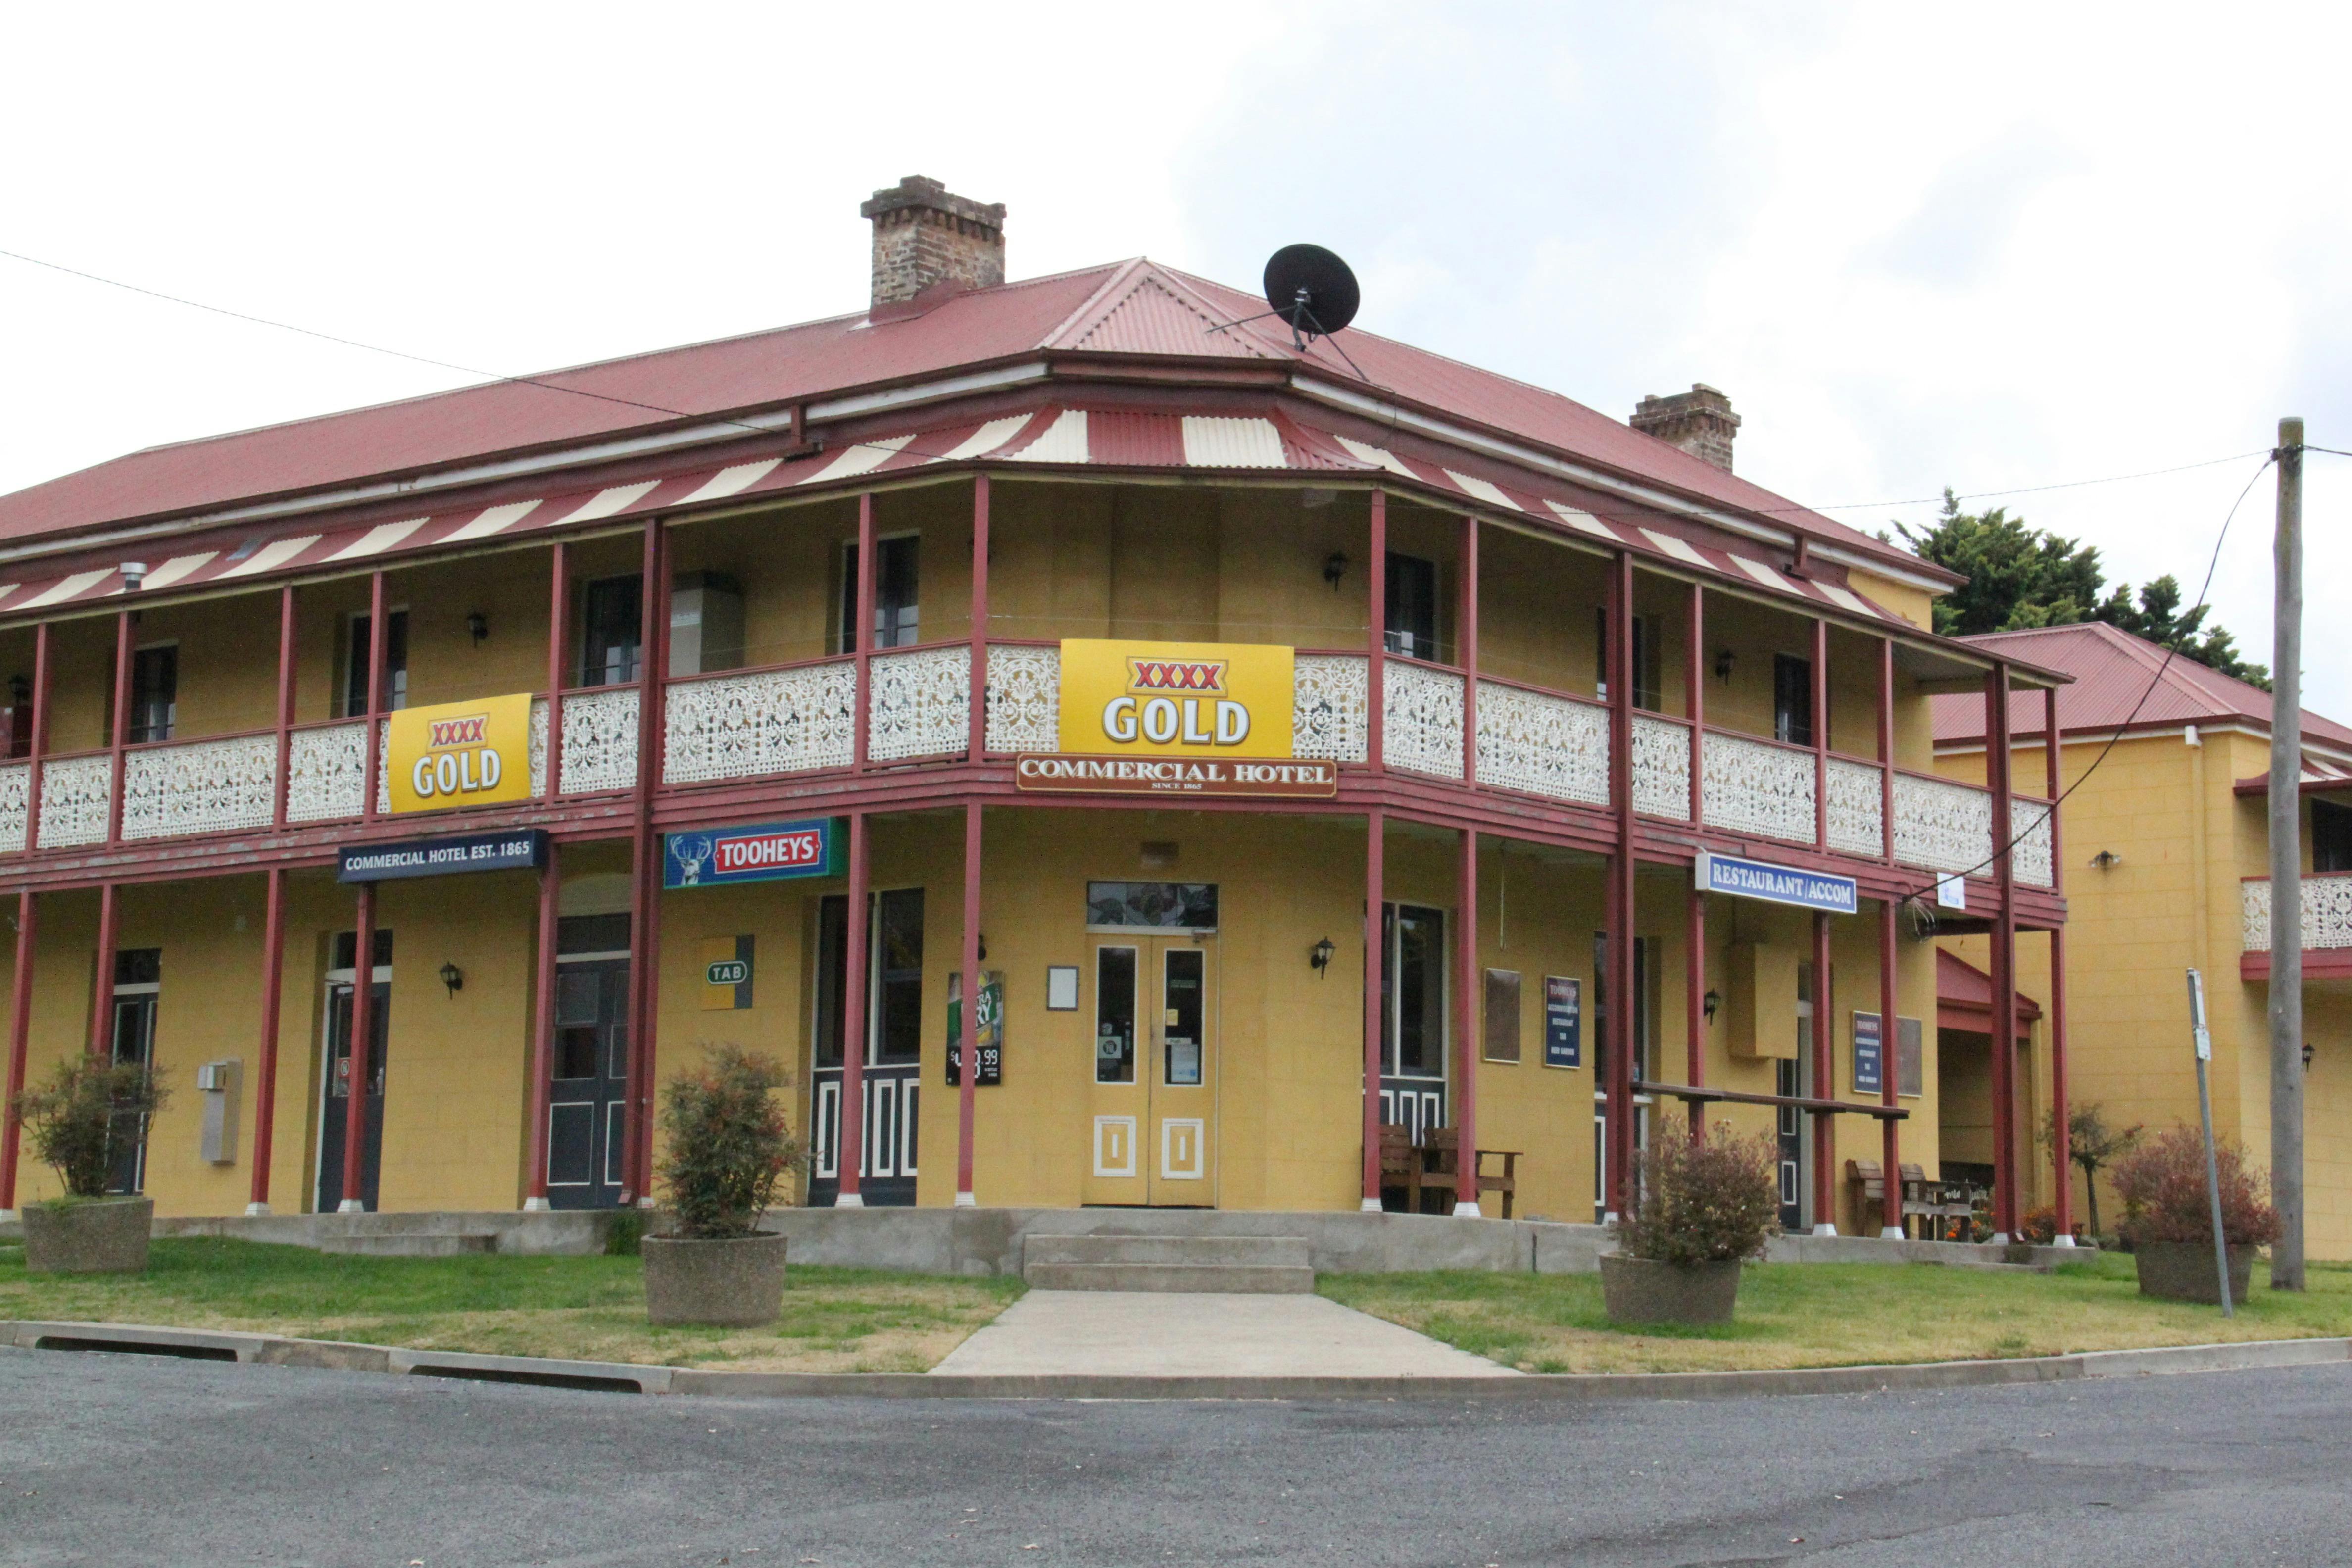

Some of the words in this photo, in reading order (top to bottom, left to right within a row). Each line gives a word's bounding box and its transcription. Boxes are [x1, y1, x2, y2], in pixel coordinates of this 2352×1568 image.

[1133, 662, 1222, 690] XXXX
[432, 718, 484, 747] XXXX
[1102, 696, 1250, 745] GOLD
[413, 749, 501, 798] GOLD
[1020, 759, 1226, 782] COMMERCIAL
[1234, 764, 1334, 784] HOTEL
[346, 851, 425, 870] COMMERCIAL
[428, 847, 467, 863] HOTEL
[471, 844, 496, 859] EST.
[500, 841, 530, 856] 1865
[721, 836, 814, 866] TOOHEYS
[713, 966, 741, 980] TAB
